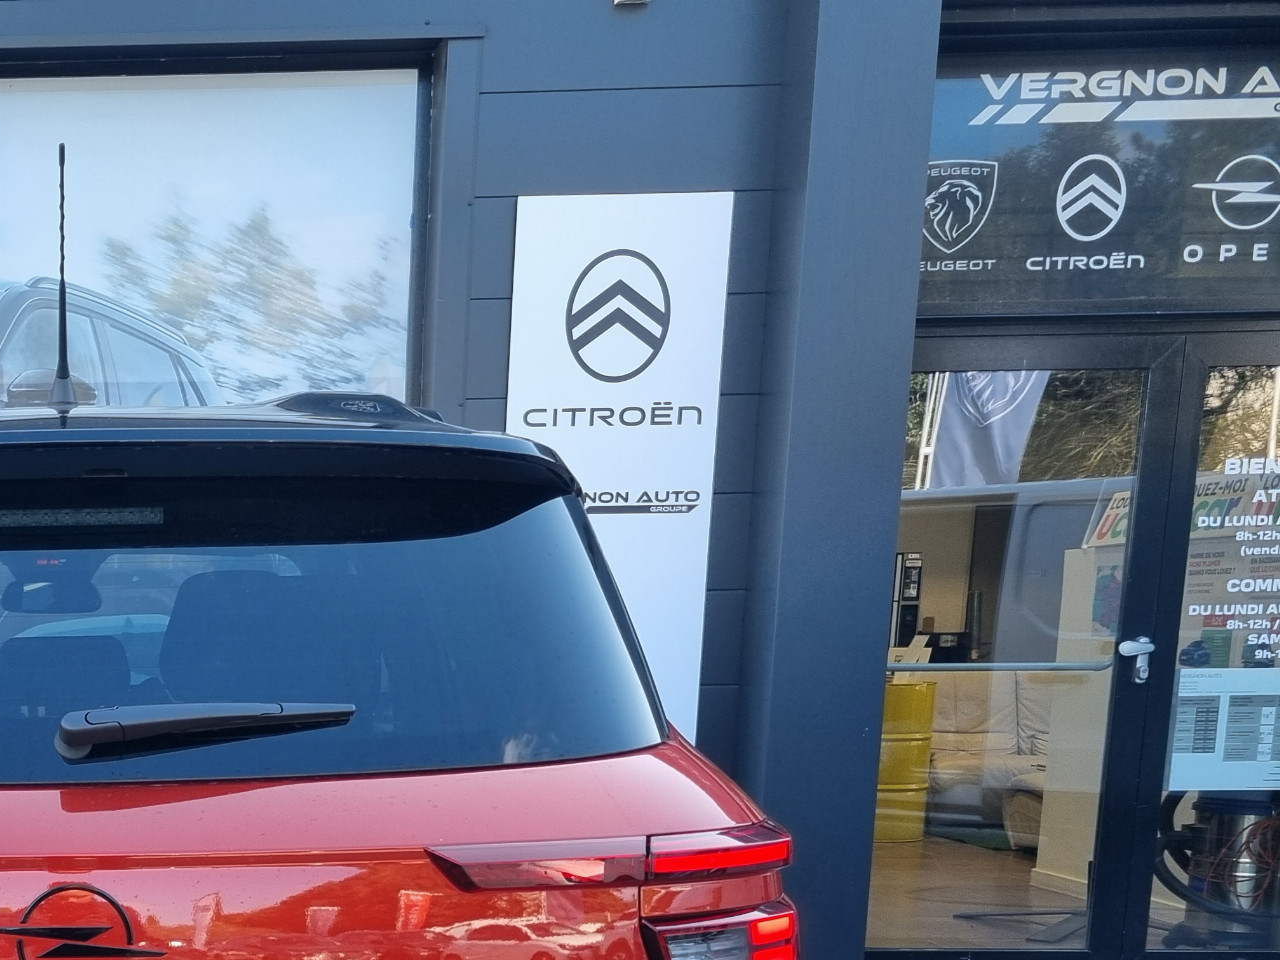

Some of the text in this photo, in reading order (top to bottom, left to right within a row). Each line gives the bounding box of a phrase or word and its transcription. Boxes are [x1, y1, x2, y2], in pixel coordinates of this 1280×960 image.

[979, 66, 1228, 100] VERGNON
[636, 490, 701, 504] AUTO
[1197, 516, 1221, 527] DU
[1224, 515, 1274, 527] LUNDI
[1188, 603, 1280, 616] DU LUNDI A
[1225, 619, 1271, 630] 8h-12h
